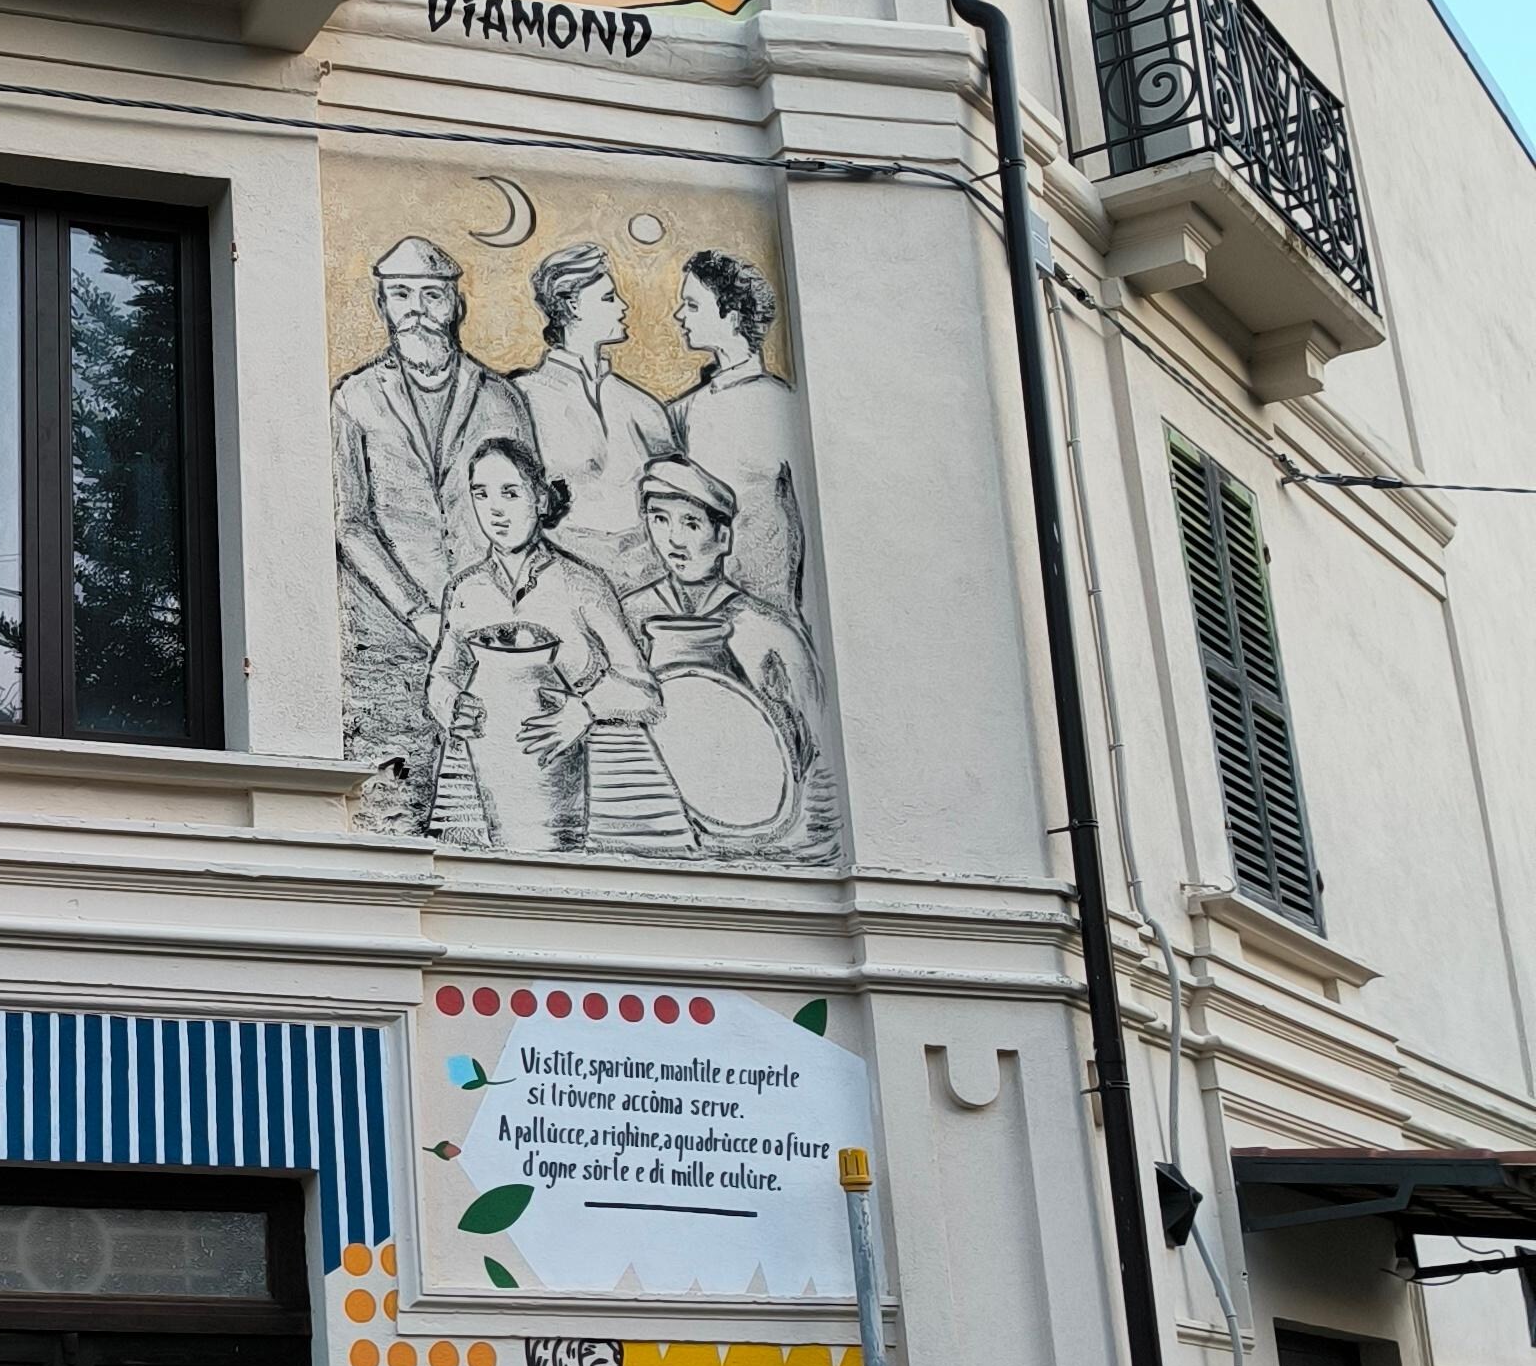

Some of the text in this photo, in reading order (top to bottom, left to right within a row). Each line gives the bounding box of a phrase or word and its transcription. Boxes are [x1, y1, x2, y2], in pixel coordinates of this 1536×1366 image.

[725, 1068, 735, 1085] e
[527, 1083, 545, 1105] si
[690, 1099, 745, 1119] serve.
[498, 1114, 512, 1141] A
[589, 1129, 599, 1146] a
[663, 1133, 672, 1150] a
[762, 1138, 772, 1155] o
[774, 1139, 784, 1156] a
[786, 1132, 831, 1162] fiure
[635, 1166, 645, 1182] e
[649, 1158, 665, 1185] di
[671, 1160, 715, 1188] mille
